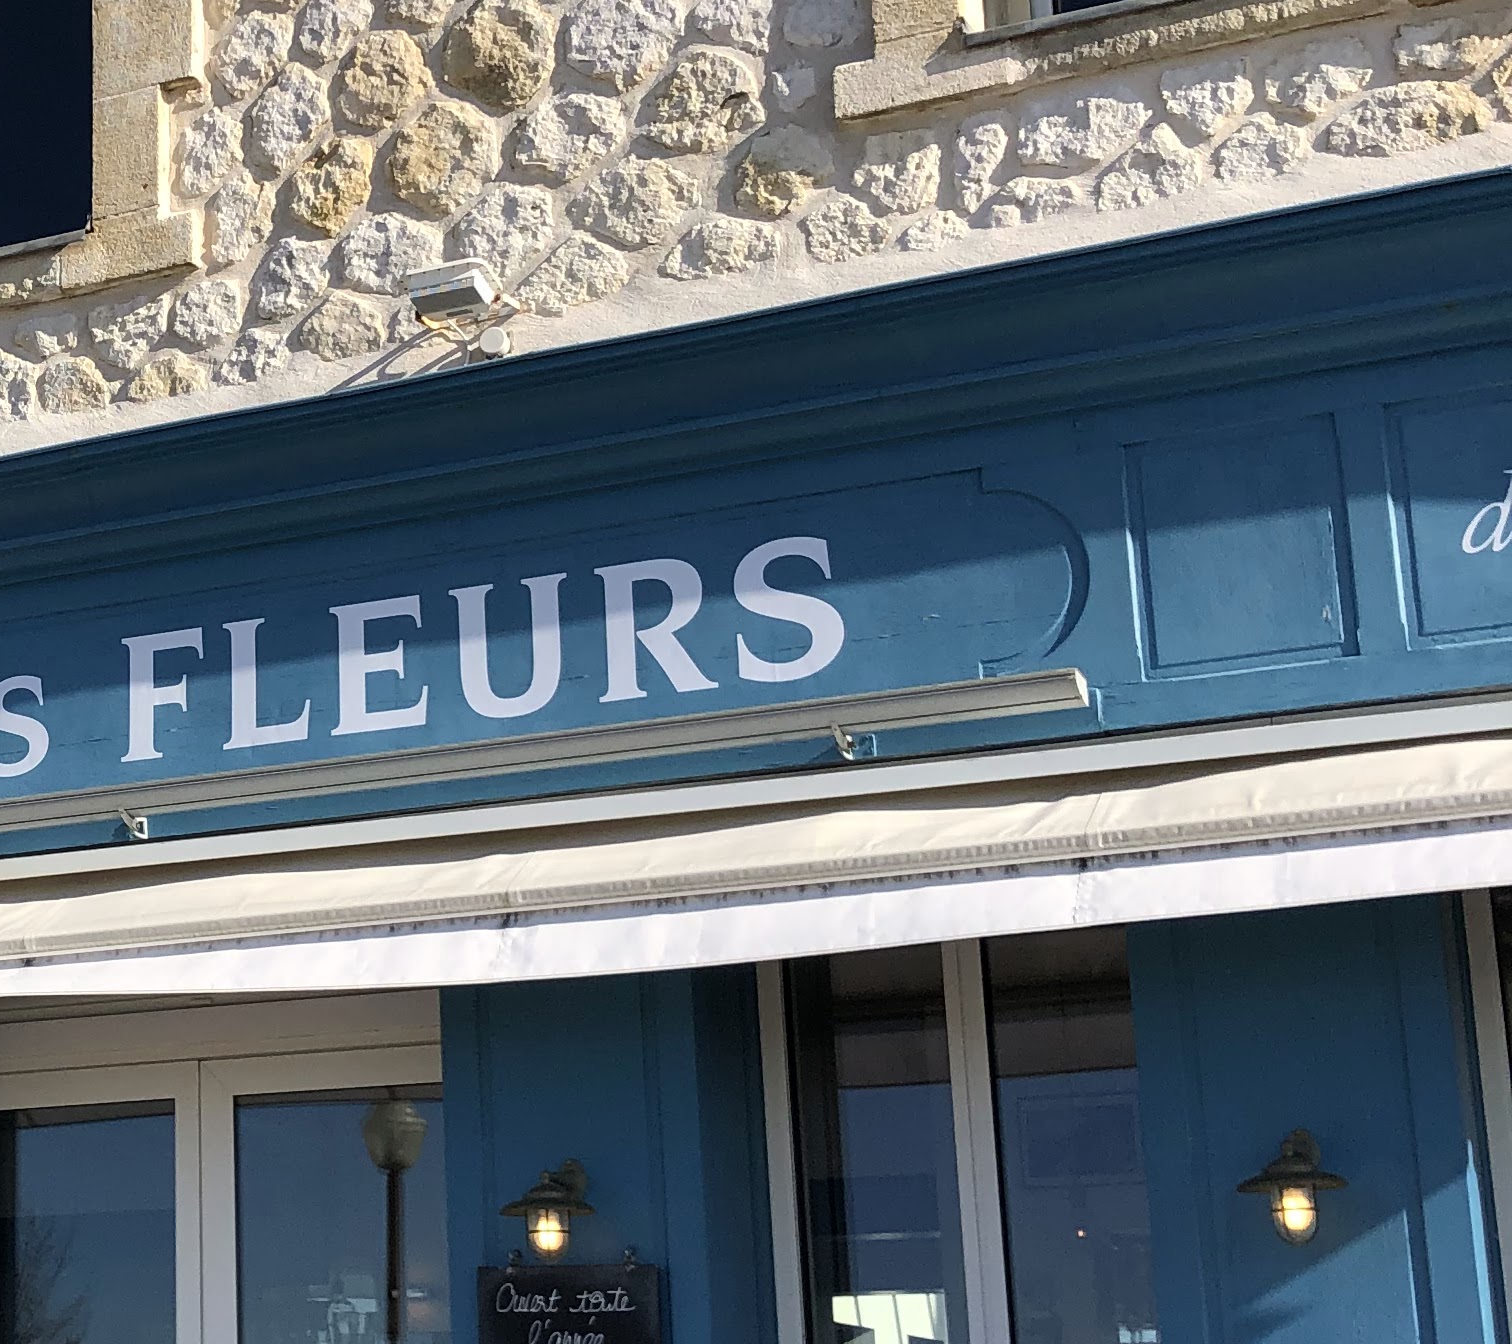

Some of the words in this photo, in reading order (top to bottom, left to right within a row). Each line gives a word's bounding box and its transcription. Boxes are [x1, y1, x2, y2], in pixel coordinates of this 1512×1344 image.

[120, 536, 845, 763] FLEURS
[496, 1283, 561, 1312] Ouvert
[569, 1287, 636, 1312] toute
